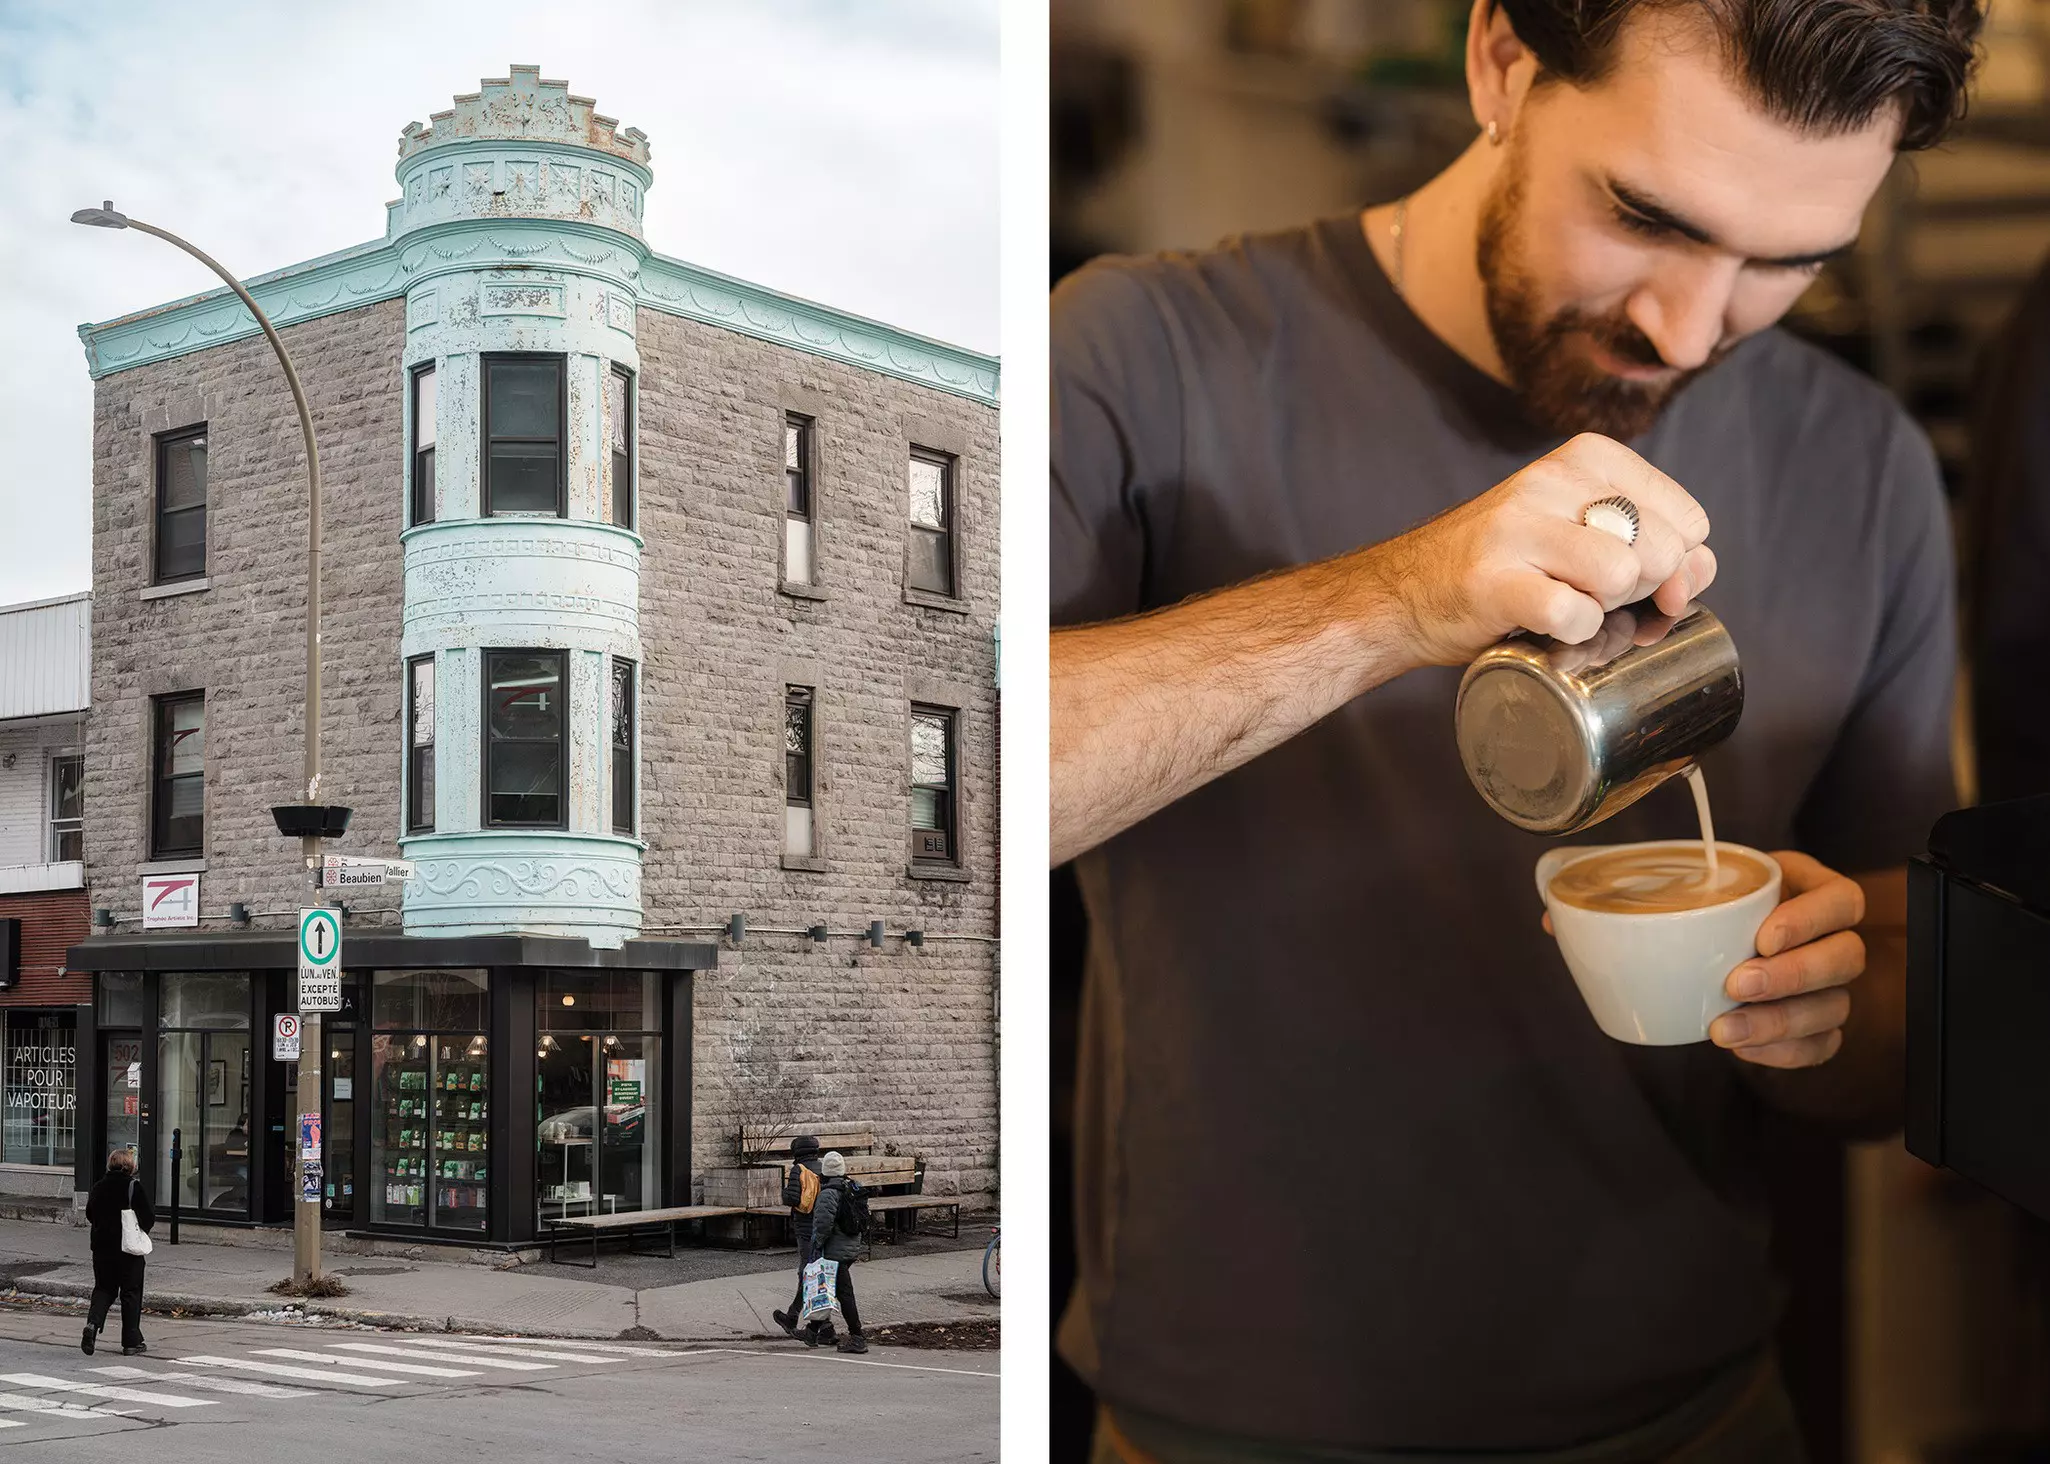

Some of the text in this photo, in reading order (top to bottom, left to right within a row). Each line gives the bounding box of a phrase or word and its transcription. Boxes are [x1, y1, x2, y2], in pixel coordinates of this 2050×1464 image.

[340, 873, 382, 884] Beaubien
[301, 996, 339, 1006] AUTOBUS
[15, 1046, 76, 1063] ARTICLES
[115, 1045, 139, 1061] 502
[27, 1069, 63, 1087] POUR
